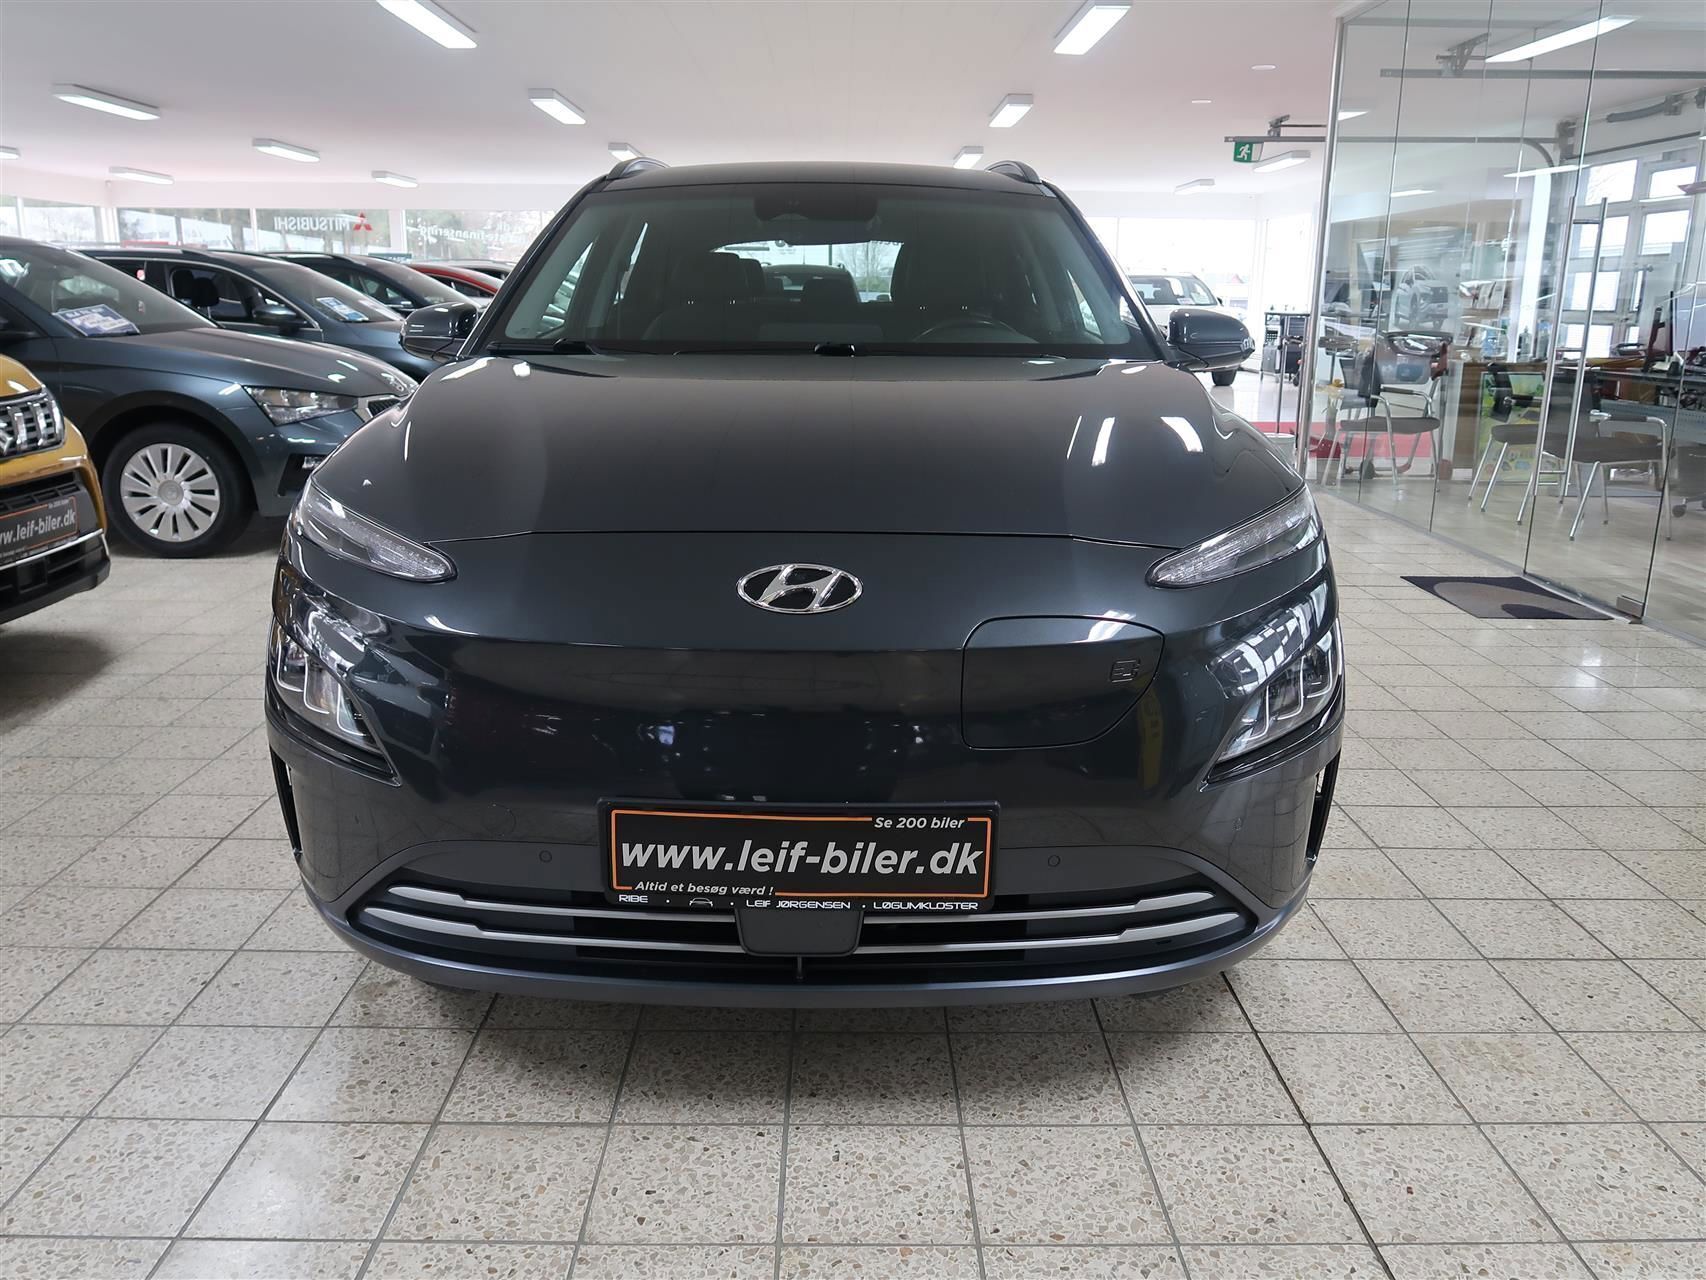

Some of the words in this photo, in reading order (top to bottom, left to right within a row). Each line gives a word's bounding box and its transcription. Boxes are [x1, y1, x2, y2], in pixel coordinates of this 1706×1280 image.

[874, 817, 892, 829] Se
[896, 817, 927, 829] 200
[931, 817, 965, 829] biler
[622, 839, 983, 874] www.leif-biler.dk
[635, 881, 667, 891] Altid
[671, 883, 684, 892] et
[688, 883, 728, 895] besøg
[618, 894, 649, 903] RIBE
[746, 899, 771, 908] LEIF
[776, 900, 850, 909] JØRGENSEN
[873, 901, 978, 910] LØGUMKLOSTER
